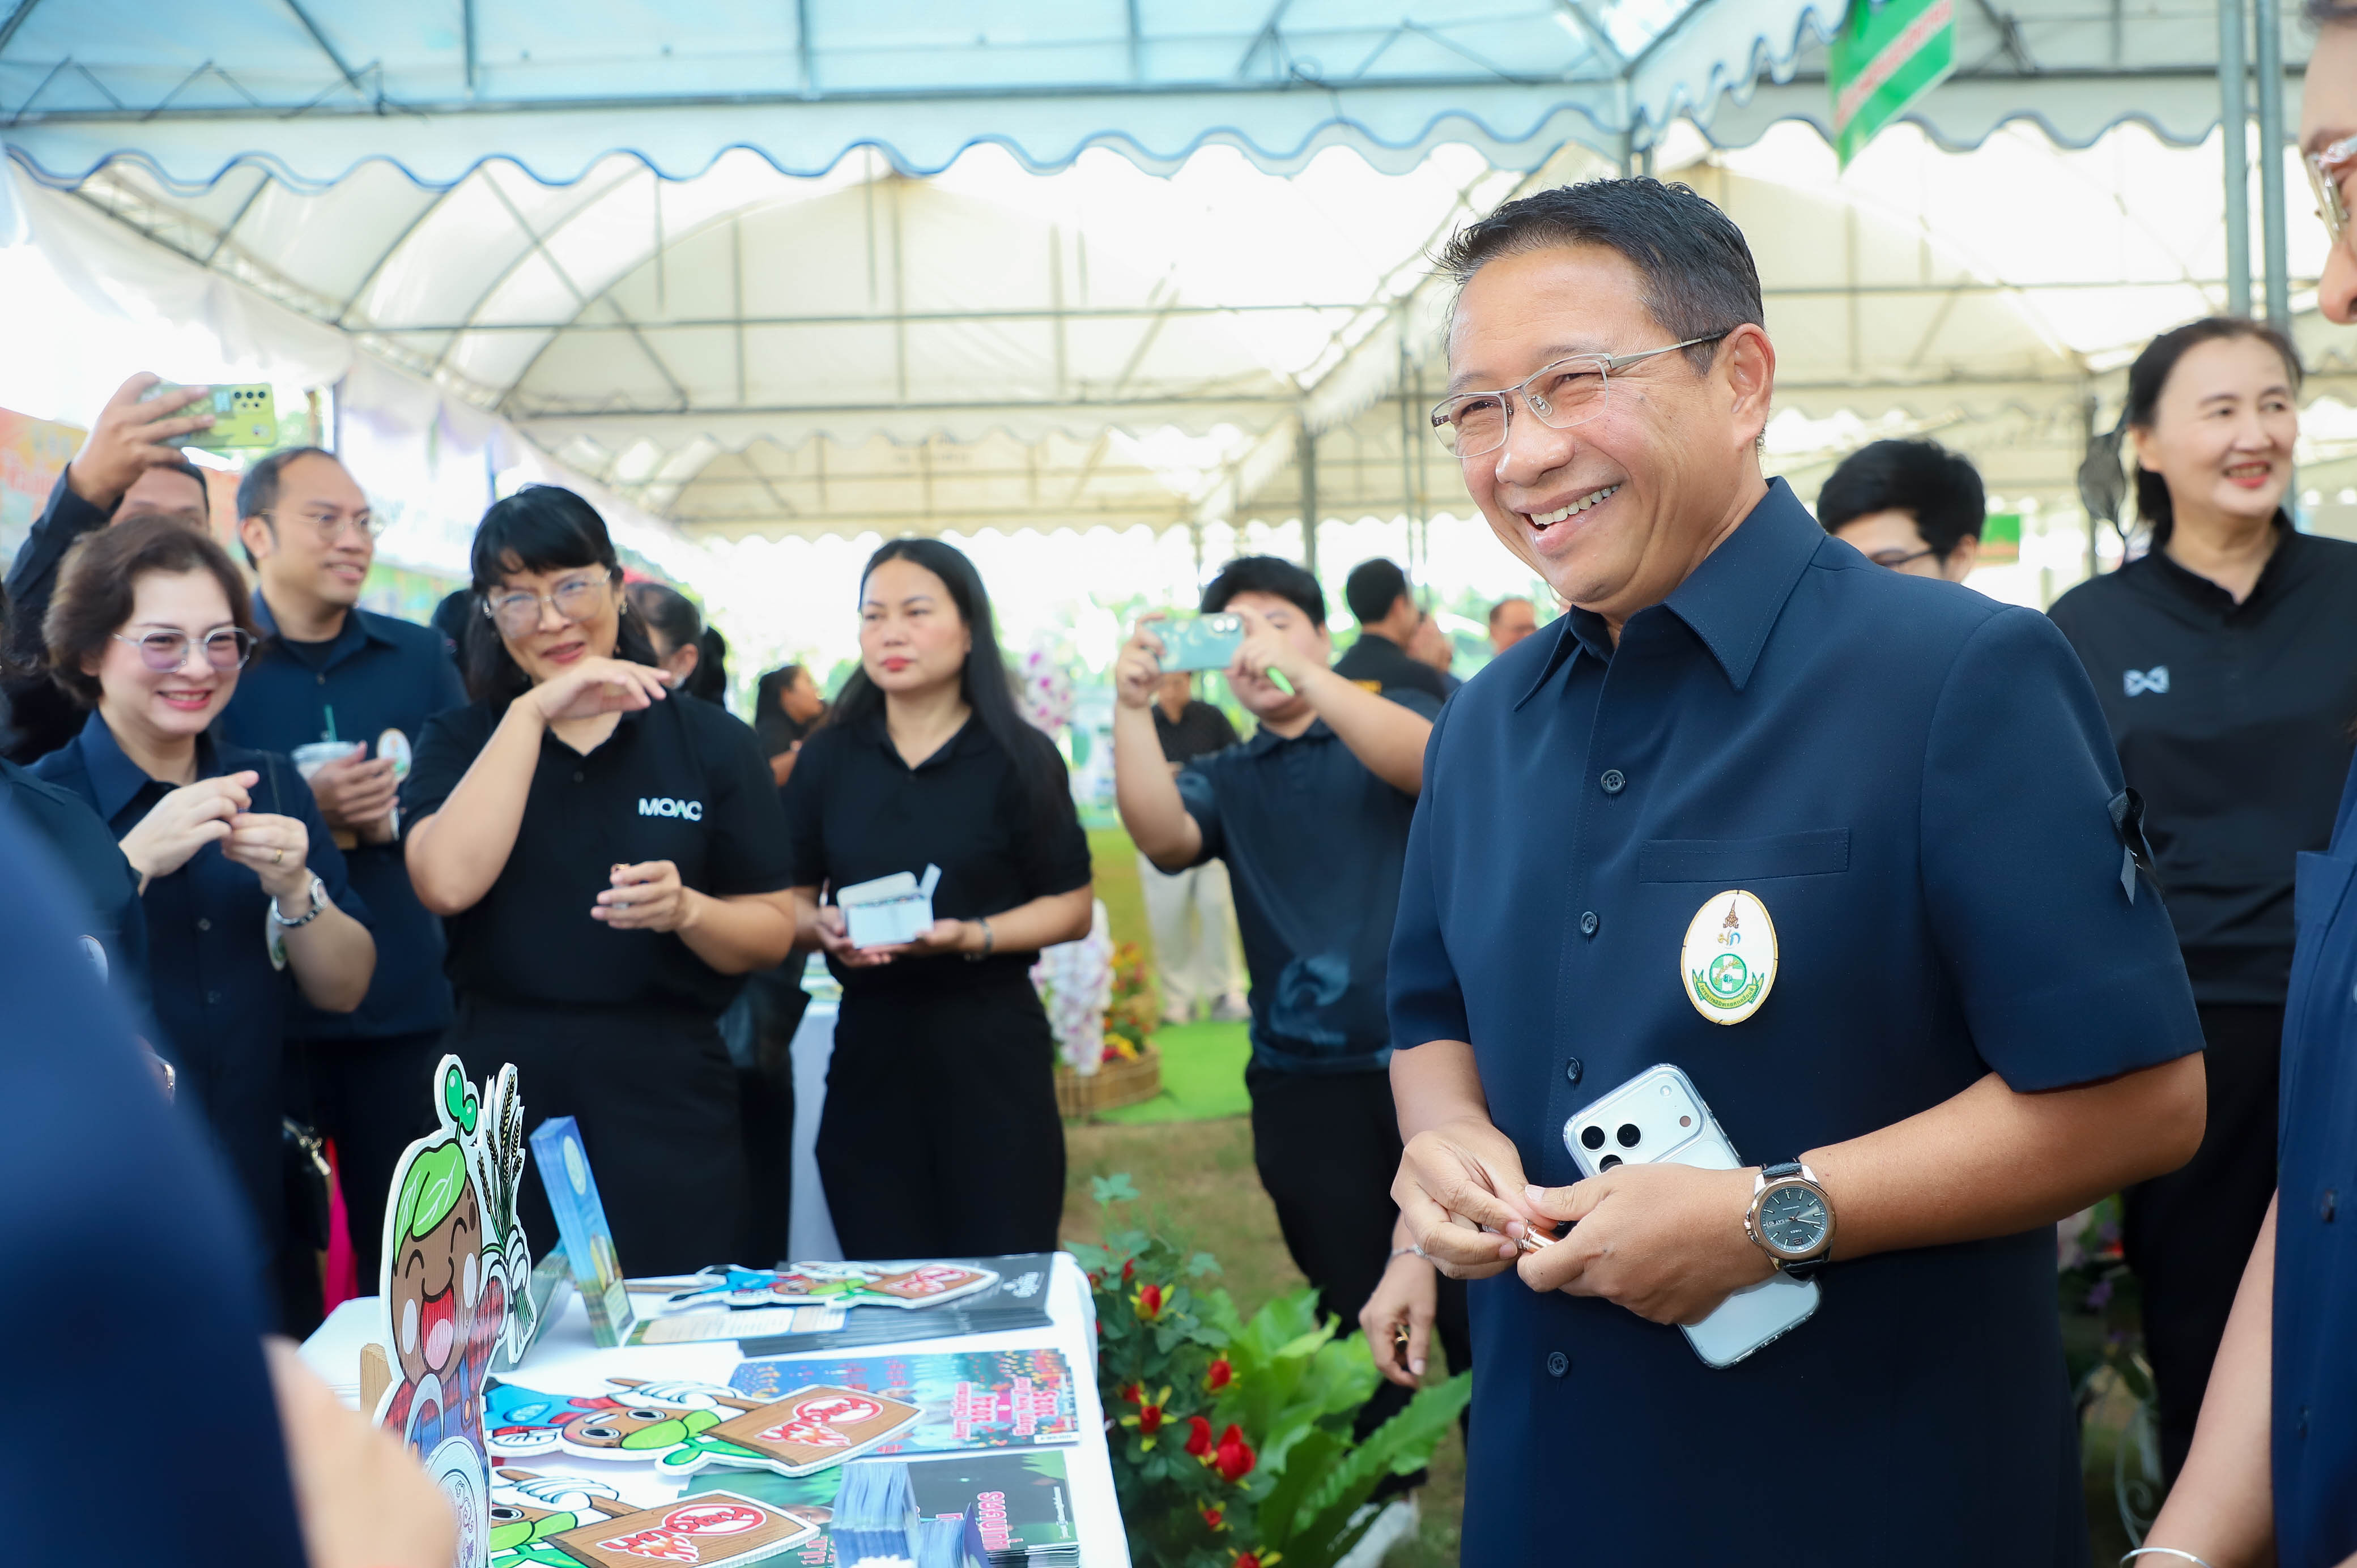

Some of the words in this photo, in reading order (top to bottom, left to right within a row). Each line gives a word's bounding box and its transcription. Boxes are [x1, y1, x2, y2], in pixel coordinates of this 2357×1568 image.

[639, 798, 703, 821] MOAC
[1792, 1236, 1805, 1246] 12
[971, 1395, 999, 1422] 2024
[1032, 1391, 1060, 1416] 2025
